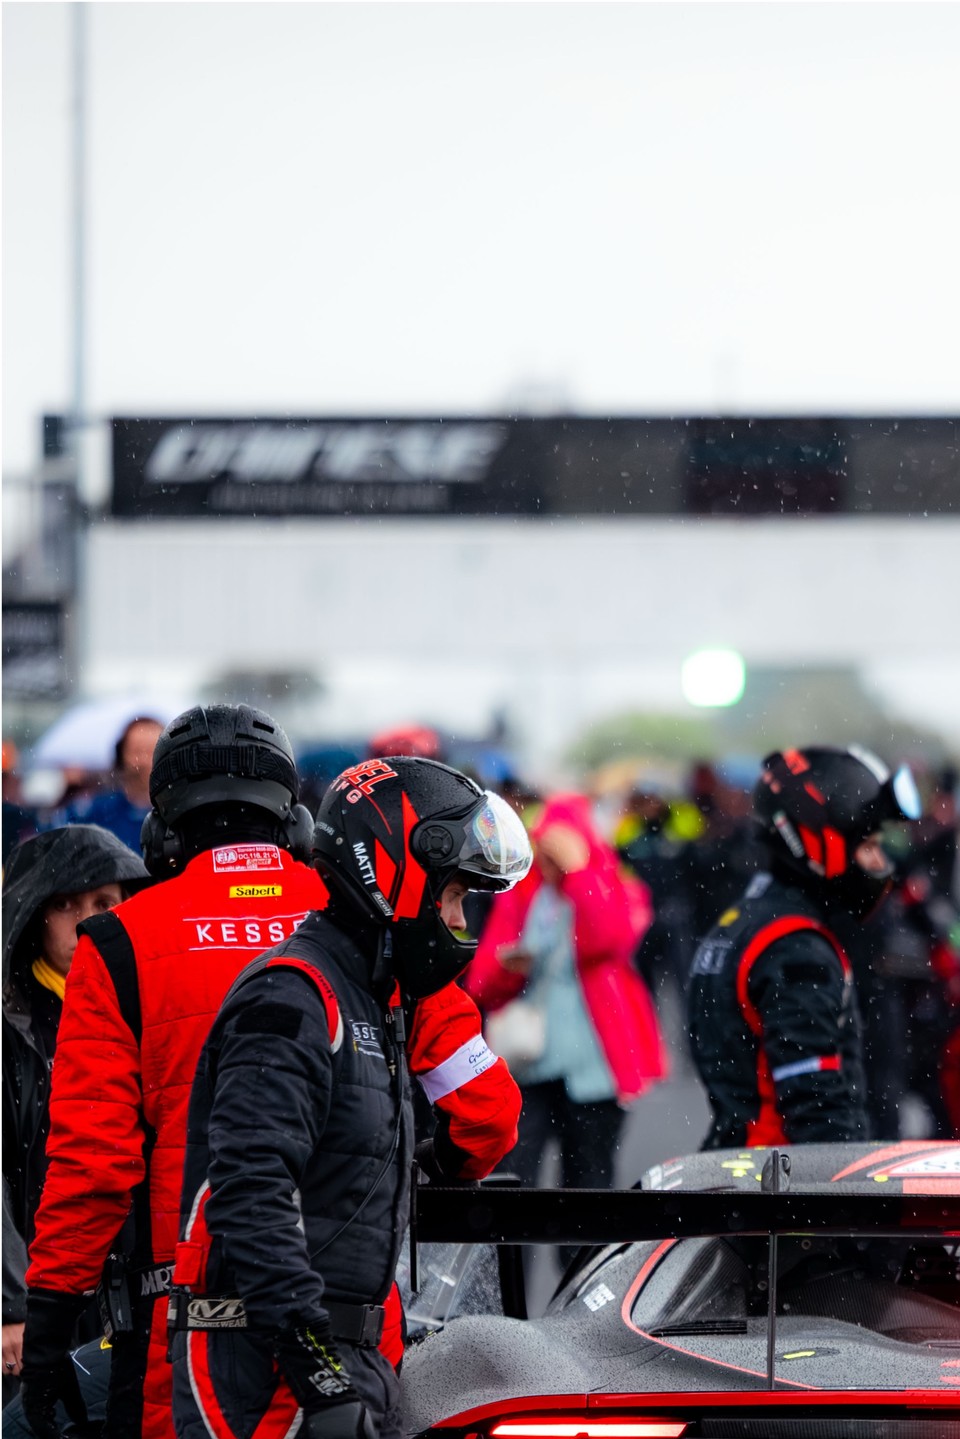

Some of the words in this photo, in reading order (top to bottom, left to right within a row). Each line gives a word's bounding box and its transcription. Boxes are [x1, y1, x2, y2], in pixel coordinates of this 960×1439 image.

[217, 850, 237, 863] FIA
[352, 841, 377, 885] MATTI
[236, 886, 276, 896] Sabelt
